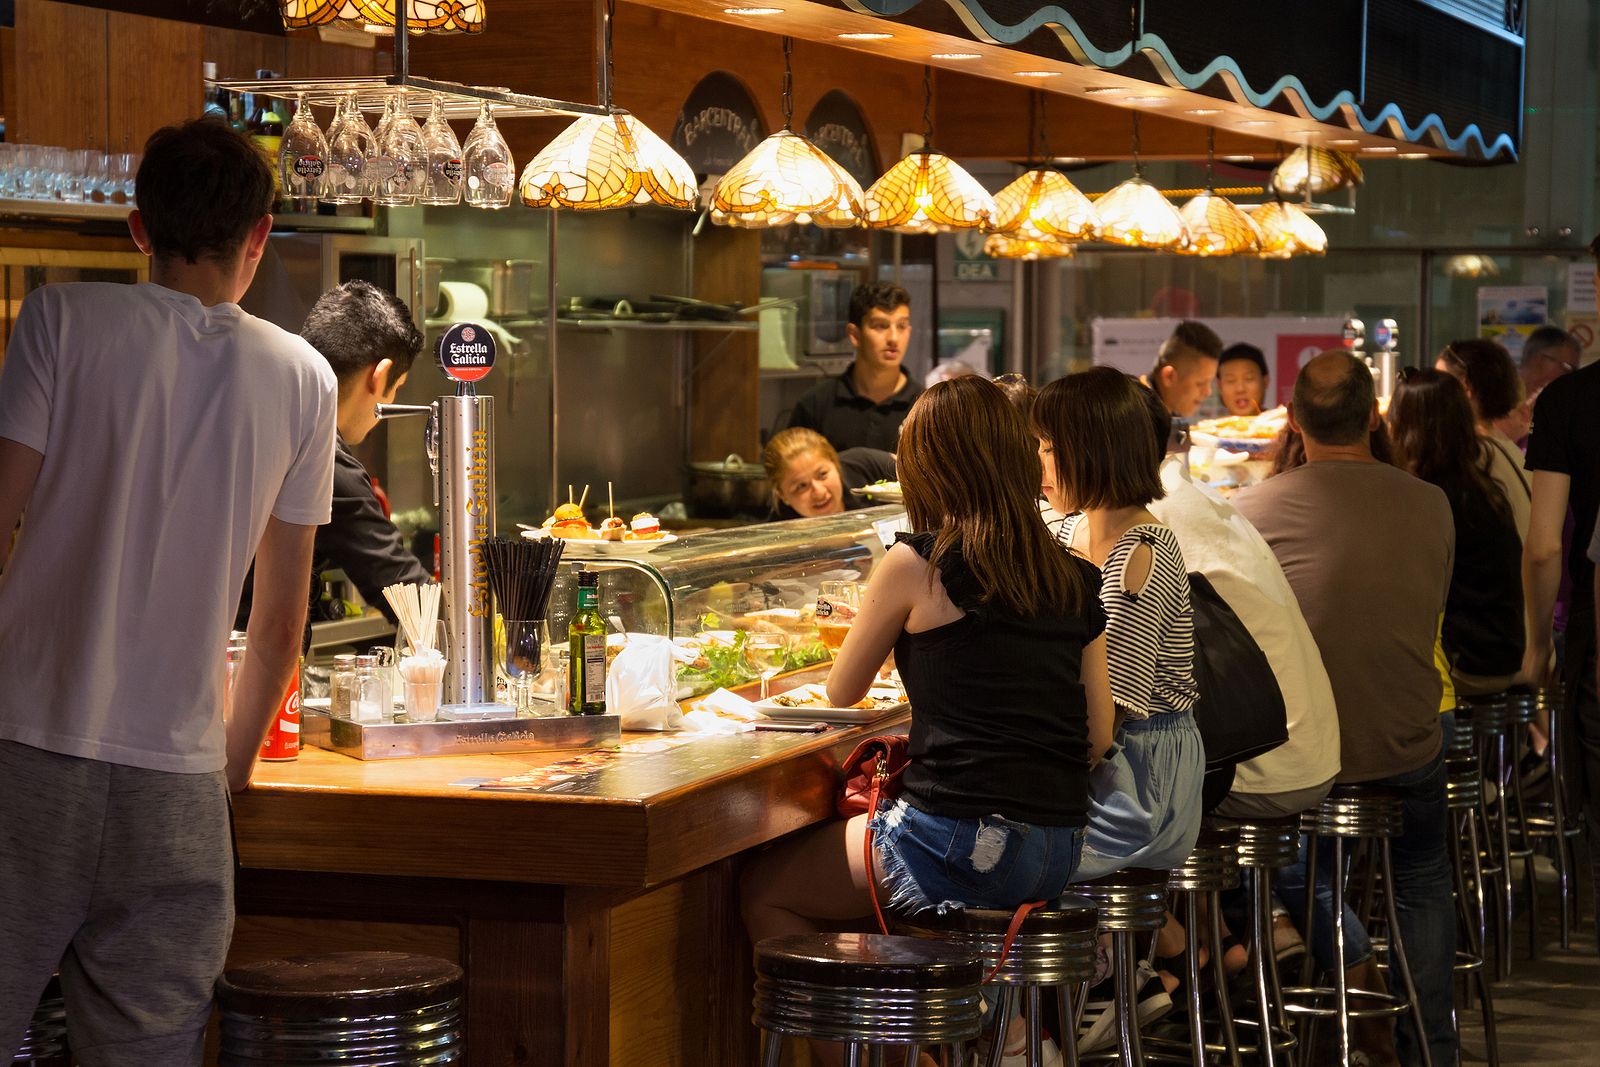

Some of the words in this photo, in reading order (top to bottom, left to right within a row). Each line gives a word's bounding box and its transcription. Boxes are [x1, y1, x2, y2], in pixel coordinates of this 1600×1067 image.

[449, 343, 488, 354] Estrella
[450, 353, 486, 365] Galicia
[465, 430, 489, 517] Galicia
